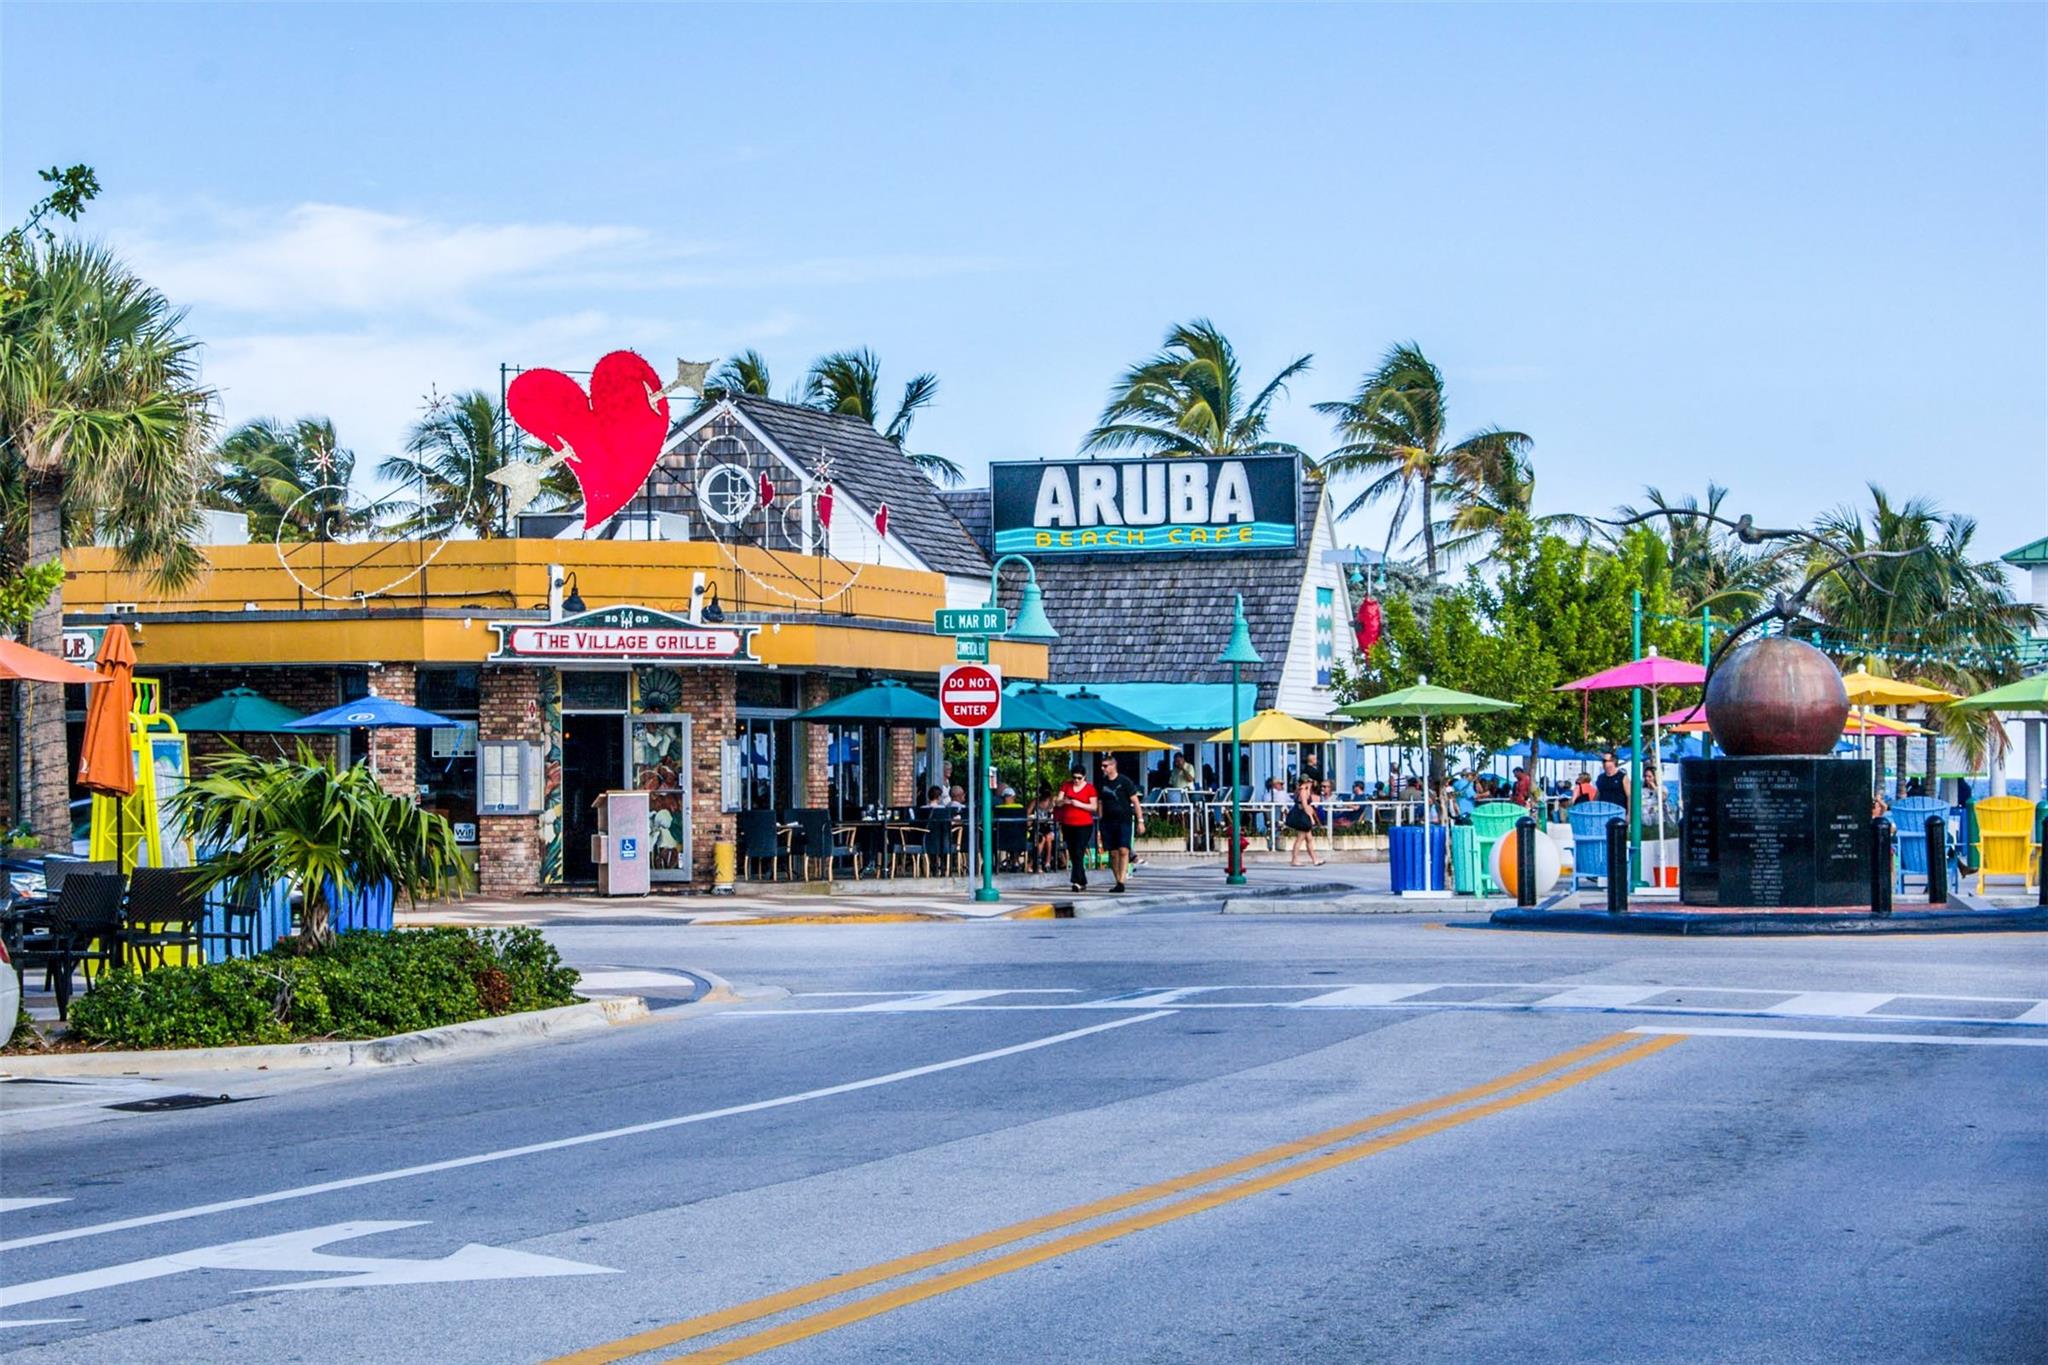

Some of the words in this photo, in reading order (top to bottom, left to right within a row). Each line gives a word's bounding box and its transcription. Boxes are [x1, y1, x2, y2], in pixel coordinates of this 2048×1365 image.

[1033, 461, 1255, 527] ARUBA
[1036, 530, 1145, 547] BEACH
[1168, 527, 1254, 544] CAFE
[943, 614, 955, 629] EL
[959, 614, 979, 629] MAR
[983, 614, 997, 628] DR
[533, 632, 569, 650] THE
[576, 632, 648, 650] VILLAGE
[656, 635, 716, 650] GRILLE
[949, 678, 964, 688] DO
[969, 678, 991, 688] NOT
[953, 705, 987, 715] ENTER
